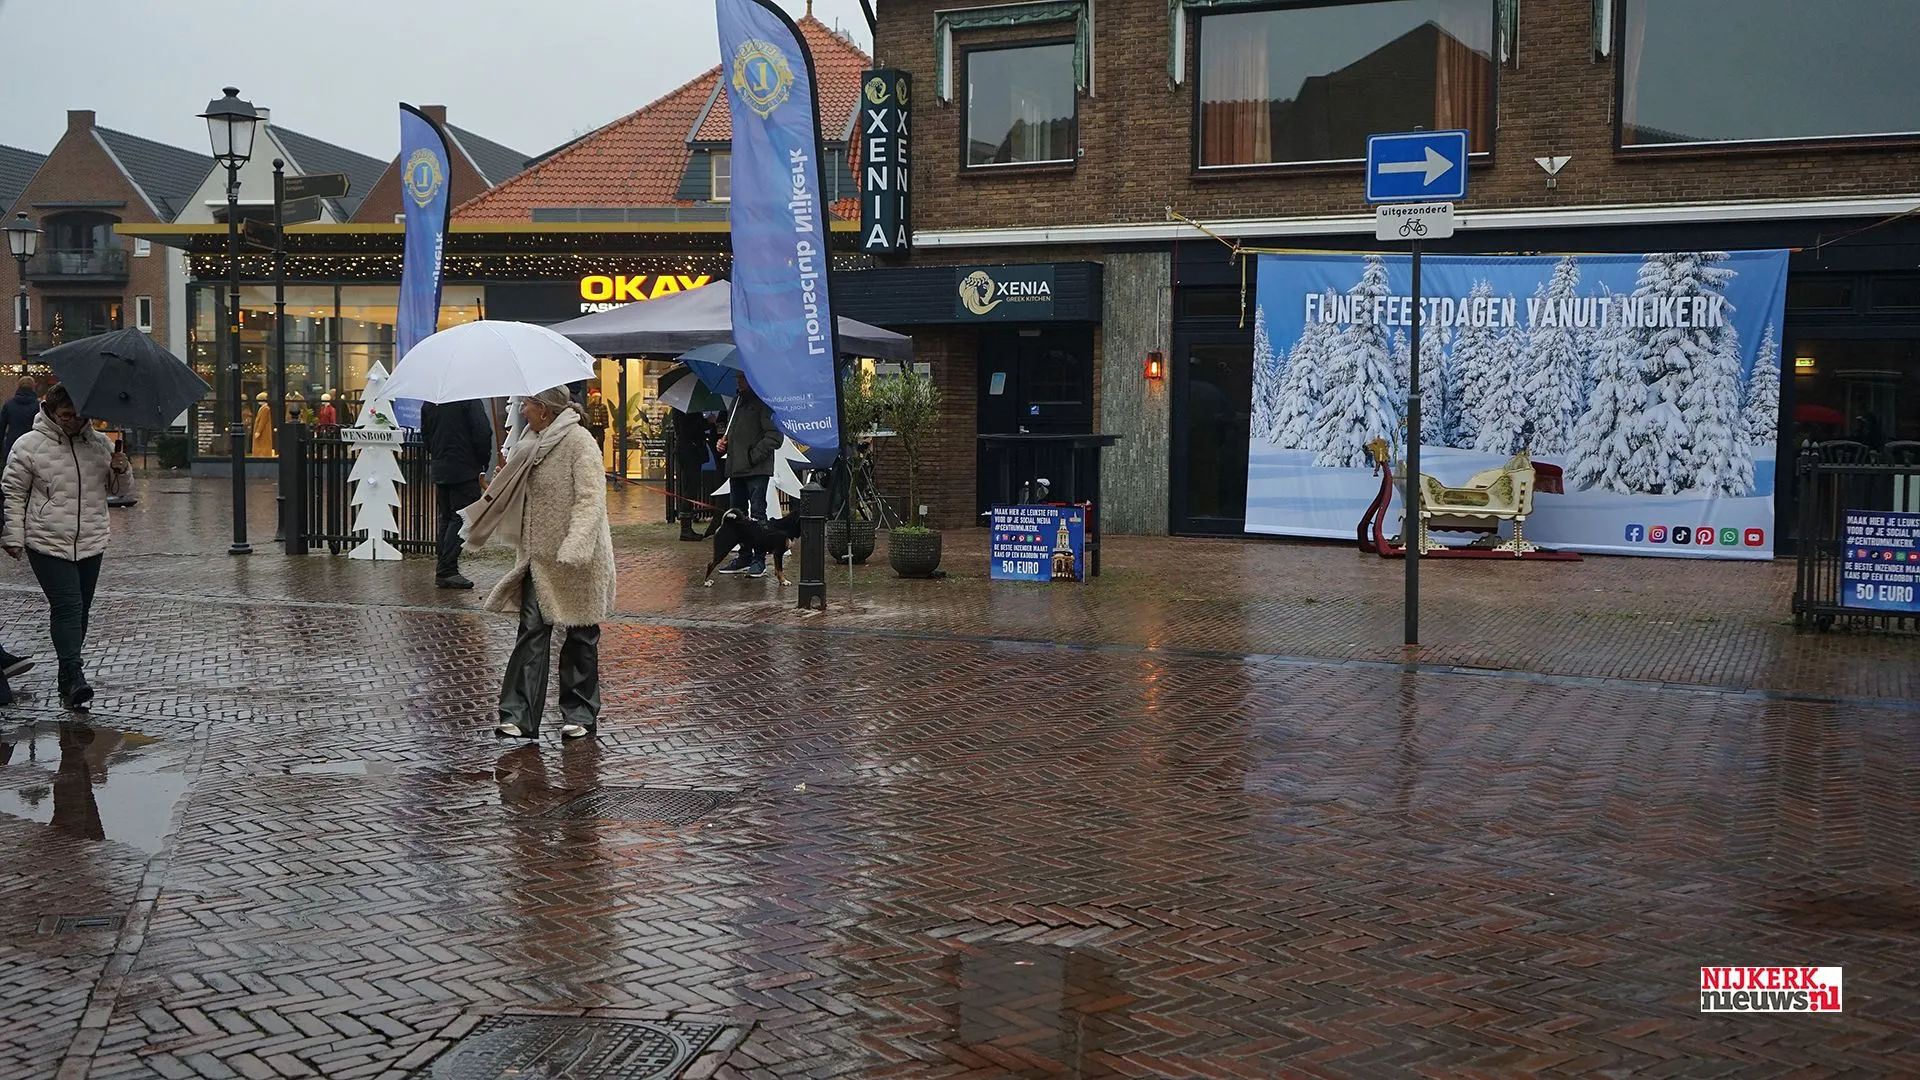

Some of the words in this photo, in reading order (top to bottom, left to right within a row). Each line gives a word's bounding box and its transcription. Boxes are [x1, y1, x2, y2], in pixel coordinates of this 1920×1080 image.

[866, 108, 889, 248] XENIA
[896, 108, 908, 249] XENIA
[1382, 205, 1447, 217] uitgezonderd
[997, 281, 1050, 295] XENIA
[1306, 293, 1363, 324] FIJNE
[1373, 296, 1515, 327] FEESTDAGEN
[1527, 297, 1612, 328] VANUIT
[1622, 296, 1724, 328] NIJKERK
[341, 431, 393, 441] WENSBOOM
[1847, 516, 1867, 524] MAAK
[1869, 517, 1885, 525] HIER
[1887, 518, 1896, 526] JE
[1847, 526, 1863, 534] VOOR
[1866, 527, 1874, 535] OP
[1876, 528, 1884, 536] JE
[1886, 528, 1910, 537] SOCIAL
[1003, 561, 1014, 573] 50
[1017, 561, 1038, 574] EURO
[1845, 562, 1853, 570] DE
[1854, 563, 1873, 571] BESTE
[1874, 564, 1904, 572] INZENDER
[1845, 571, 1860, 579] KANS
[1862, 572, 1870, 580] OP
[1856, 584, 1874, 599] 50
[1879, 585, 1913, 602] EURO
